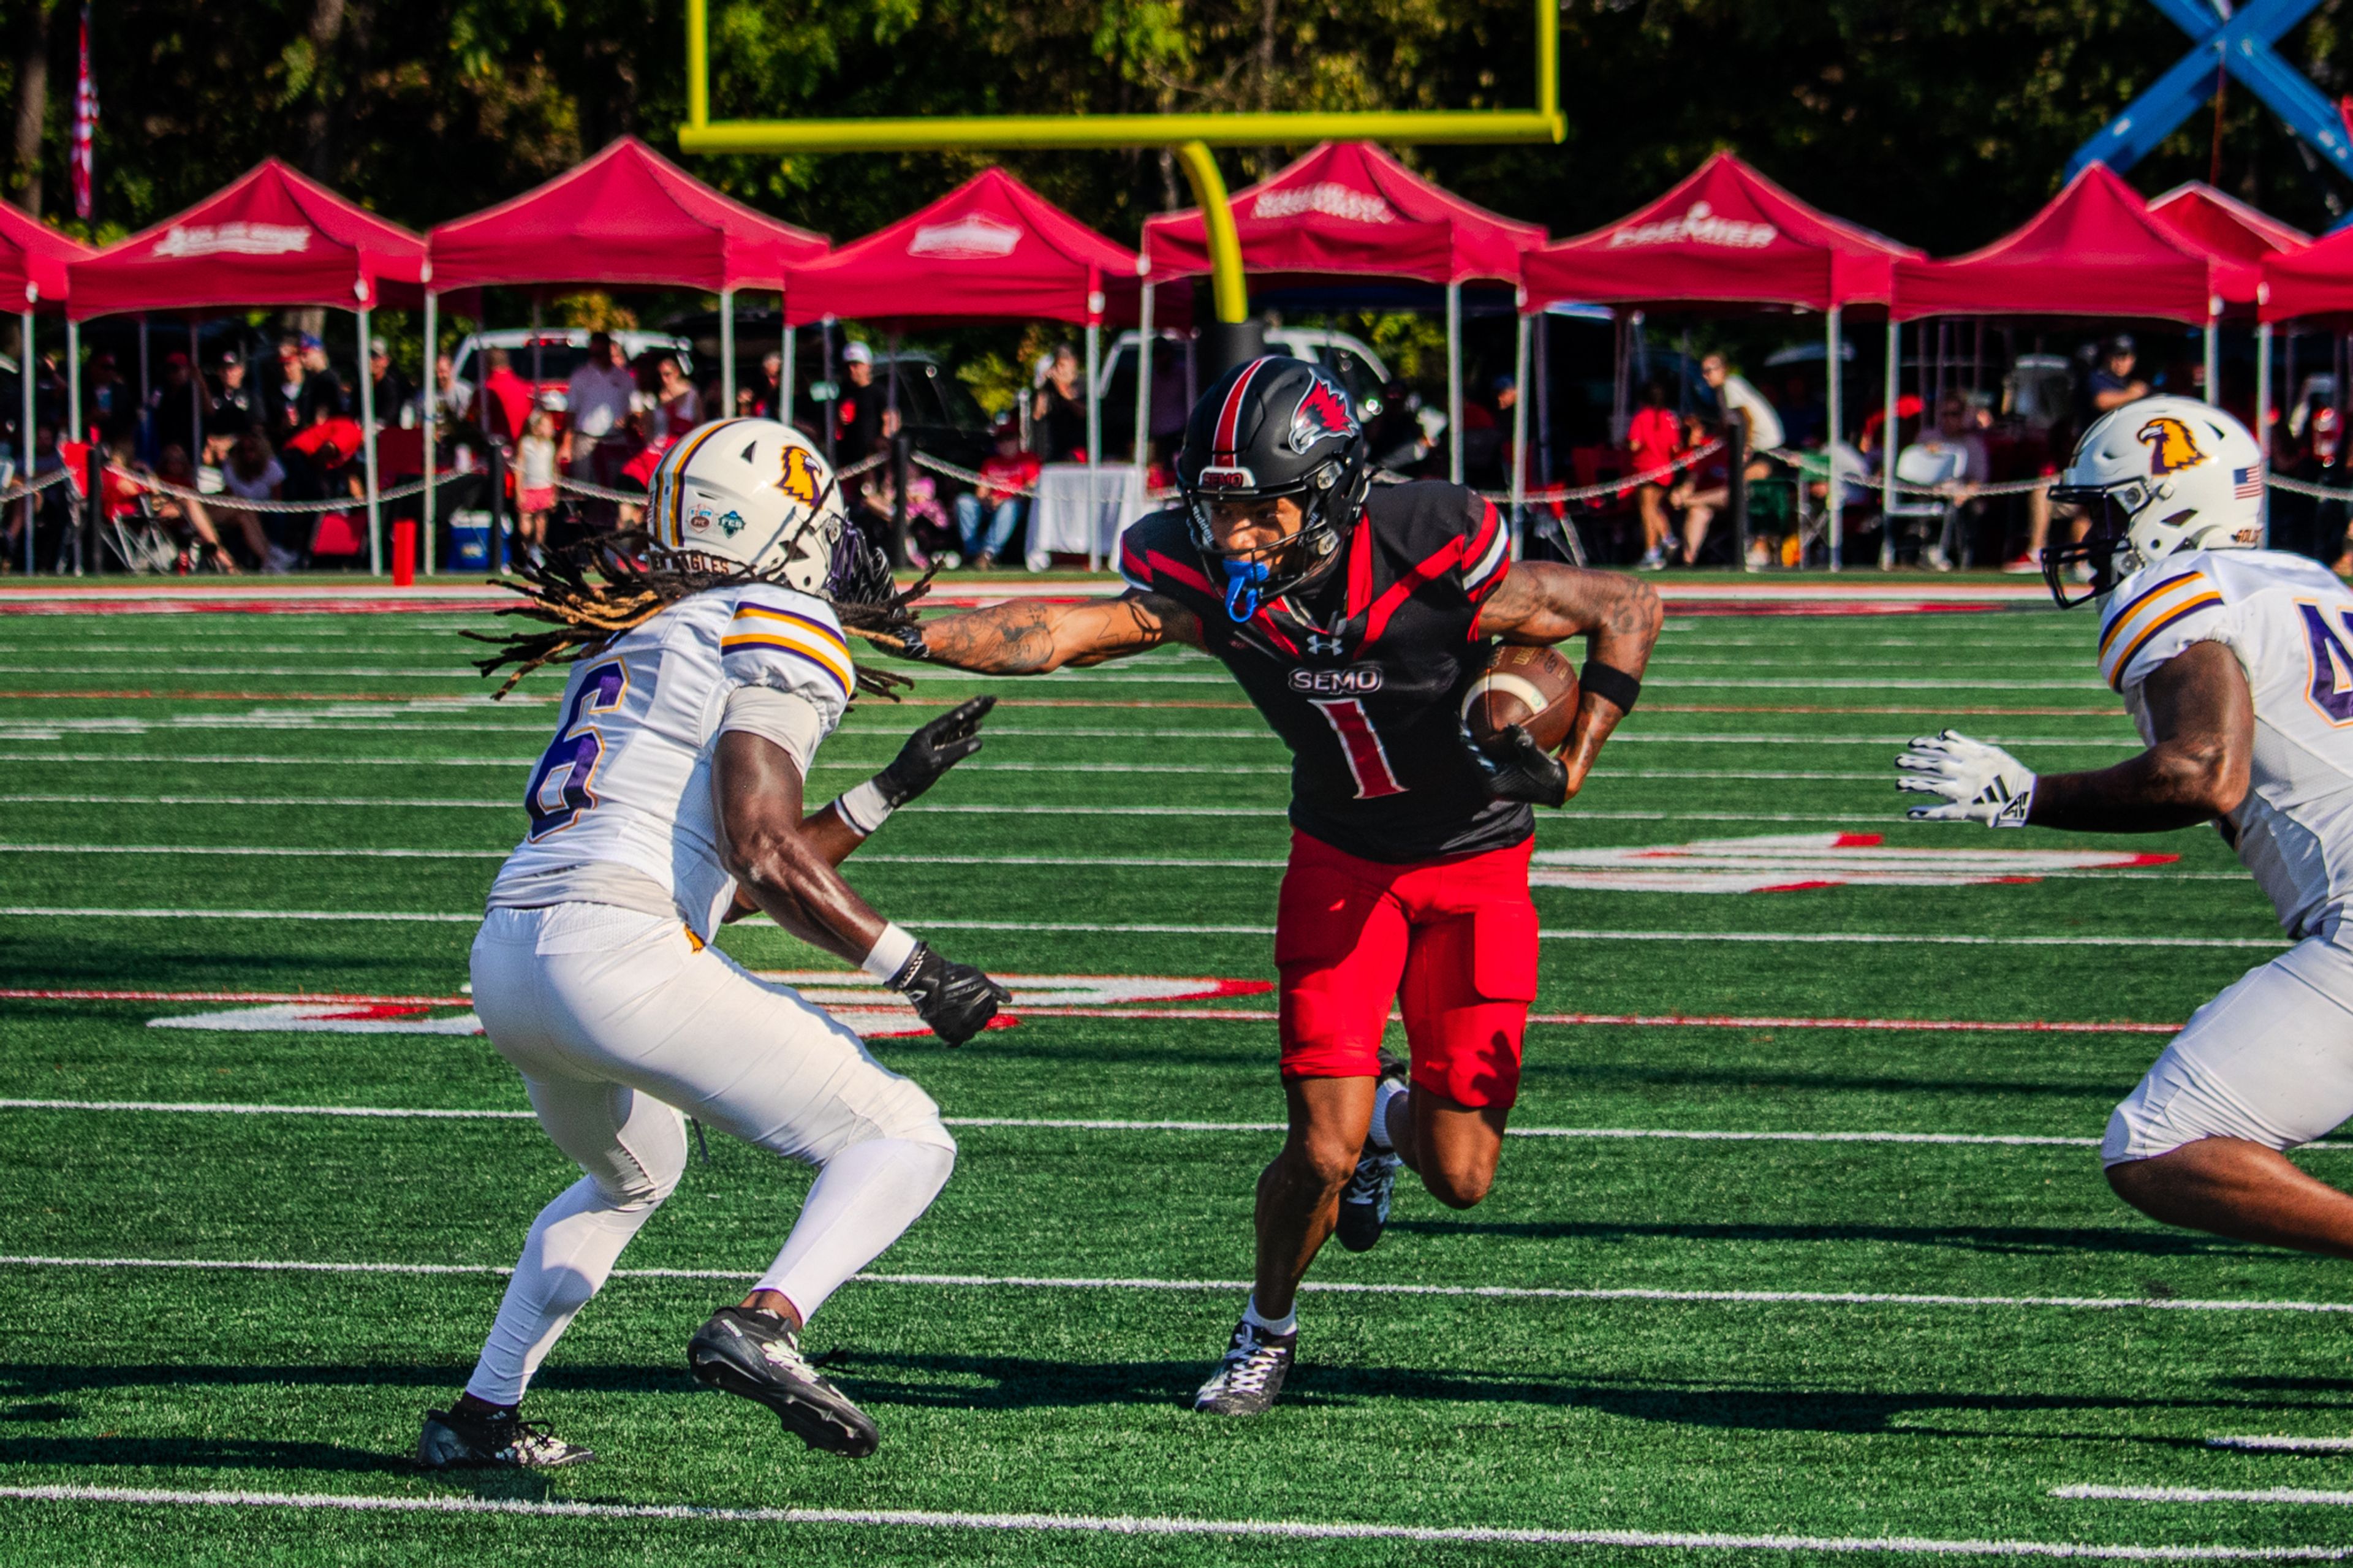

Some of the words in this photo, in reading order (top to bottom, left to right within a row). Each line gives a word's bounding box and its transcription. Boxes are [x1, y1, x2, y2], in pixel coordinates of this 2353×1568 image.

[1203, 472, 1244, 488] SEMO
[1292, 669, 1381, 692] SEMO
[527, 656, 630, 844] 6
[1306, 697, 1410, 800] 1
